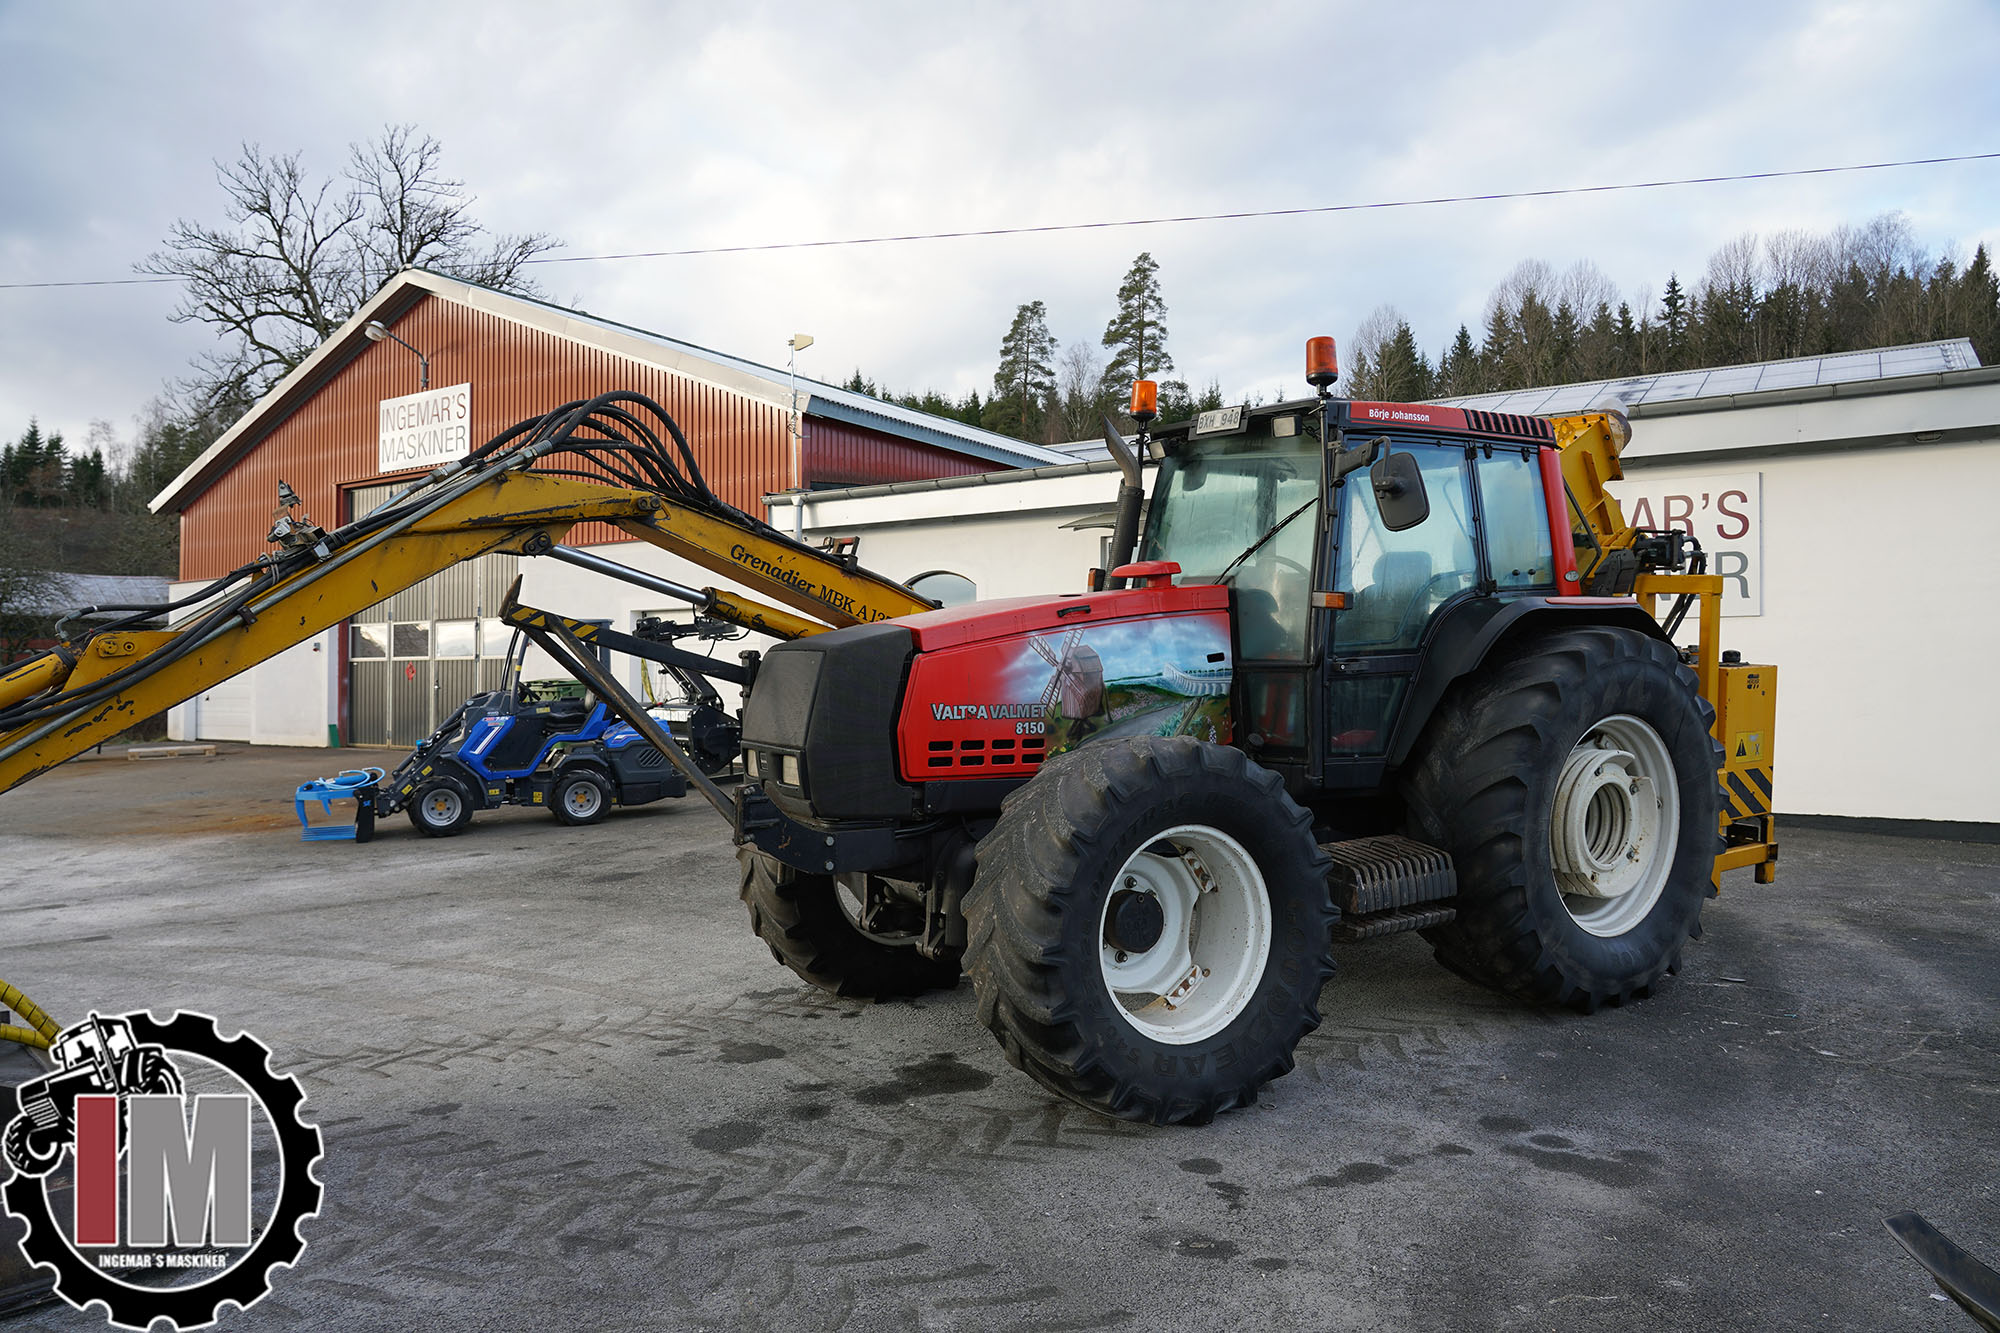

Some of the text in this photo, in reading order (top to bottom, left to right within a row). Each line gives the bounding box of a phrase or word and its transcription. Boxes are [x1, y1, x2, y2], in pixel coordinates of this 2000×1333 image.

[382, 392, 467, 433] INGEMAR'S
[1221, 411, 1240, 425] 948
[1369, 408, 1430, 422] Börje Johansson
[382, 425, 466, 463] MASKINER
[730, 543, 816, 594] Grenadier
[819, 584, 856, 614] MBK
[930, 703, 1047, 720] VALTRA VALMET
[1015, 721, 1045, 735] 8150
